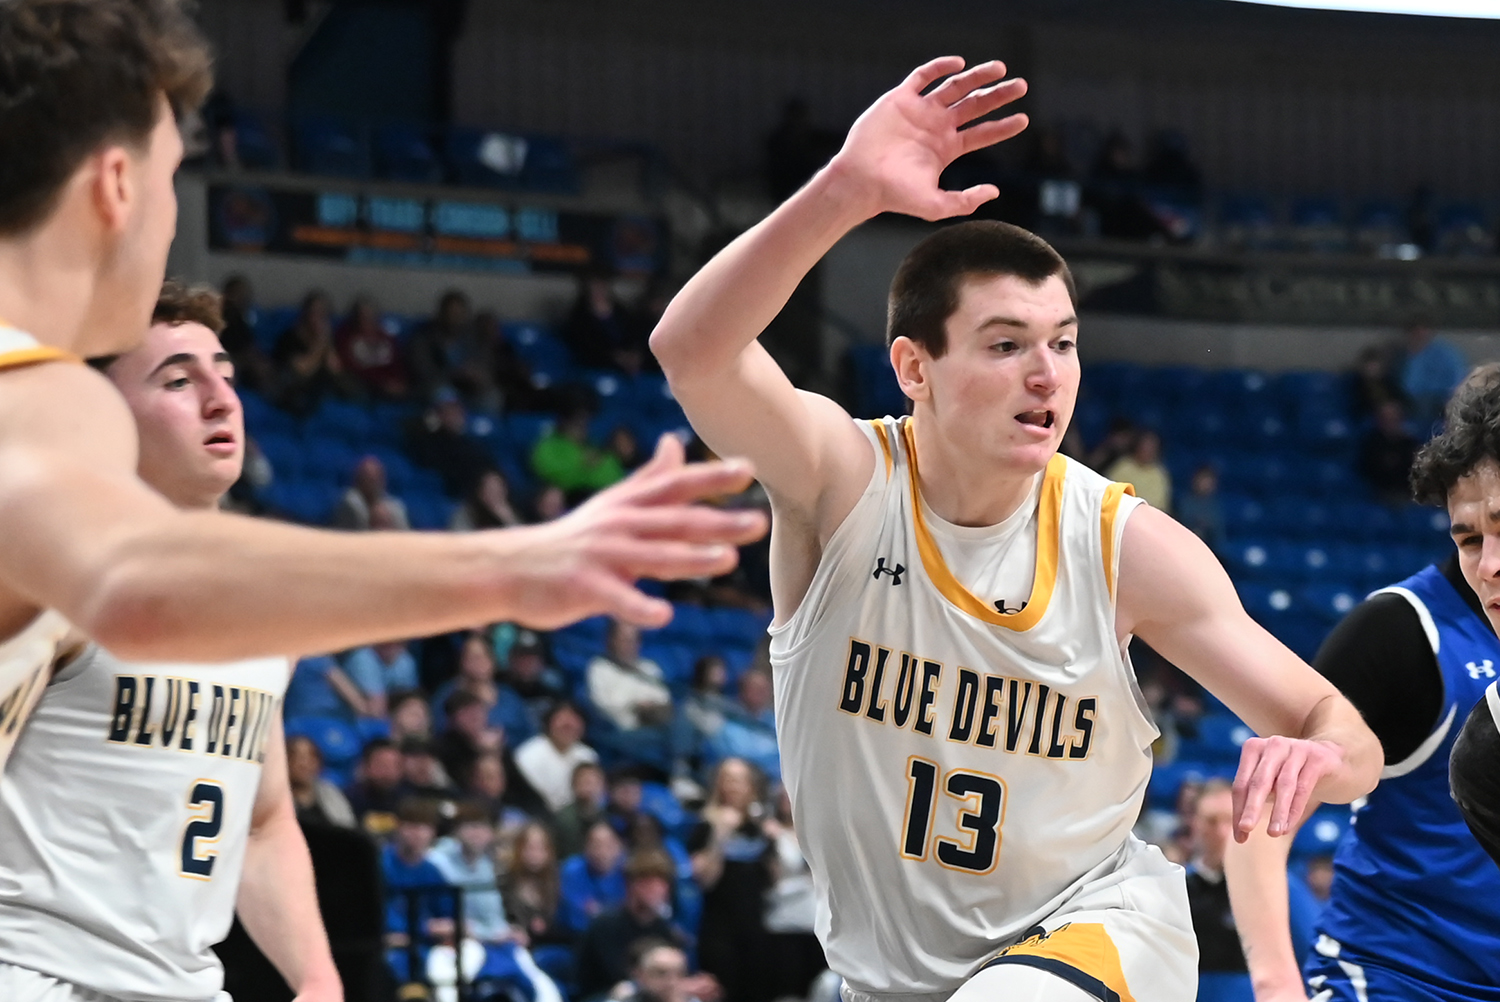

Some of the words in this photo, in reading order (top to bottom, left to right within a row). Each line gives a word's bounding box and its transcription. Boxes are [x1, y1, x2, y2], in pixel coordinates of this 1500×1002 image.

[107, 674, 201, 752] BLUE
[205, 684, 281, 764] DEVIL
[837, 636, 943, 737] BLUE
[947, 667, 1098, 762] DEVILS
[178, 778, 224, 881] 2
[900, 755, 1008, 876] 13
